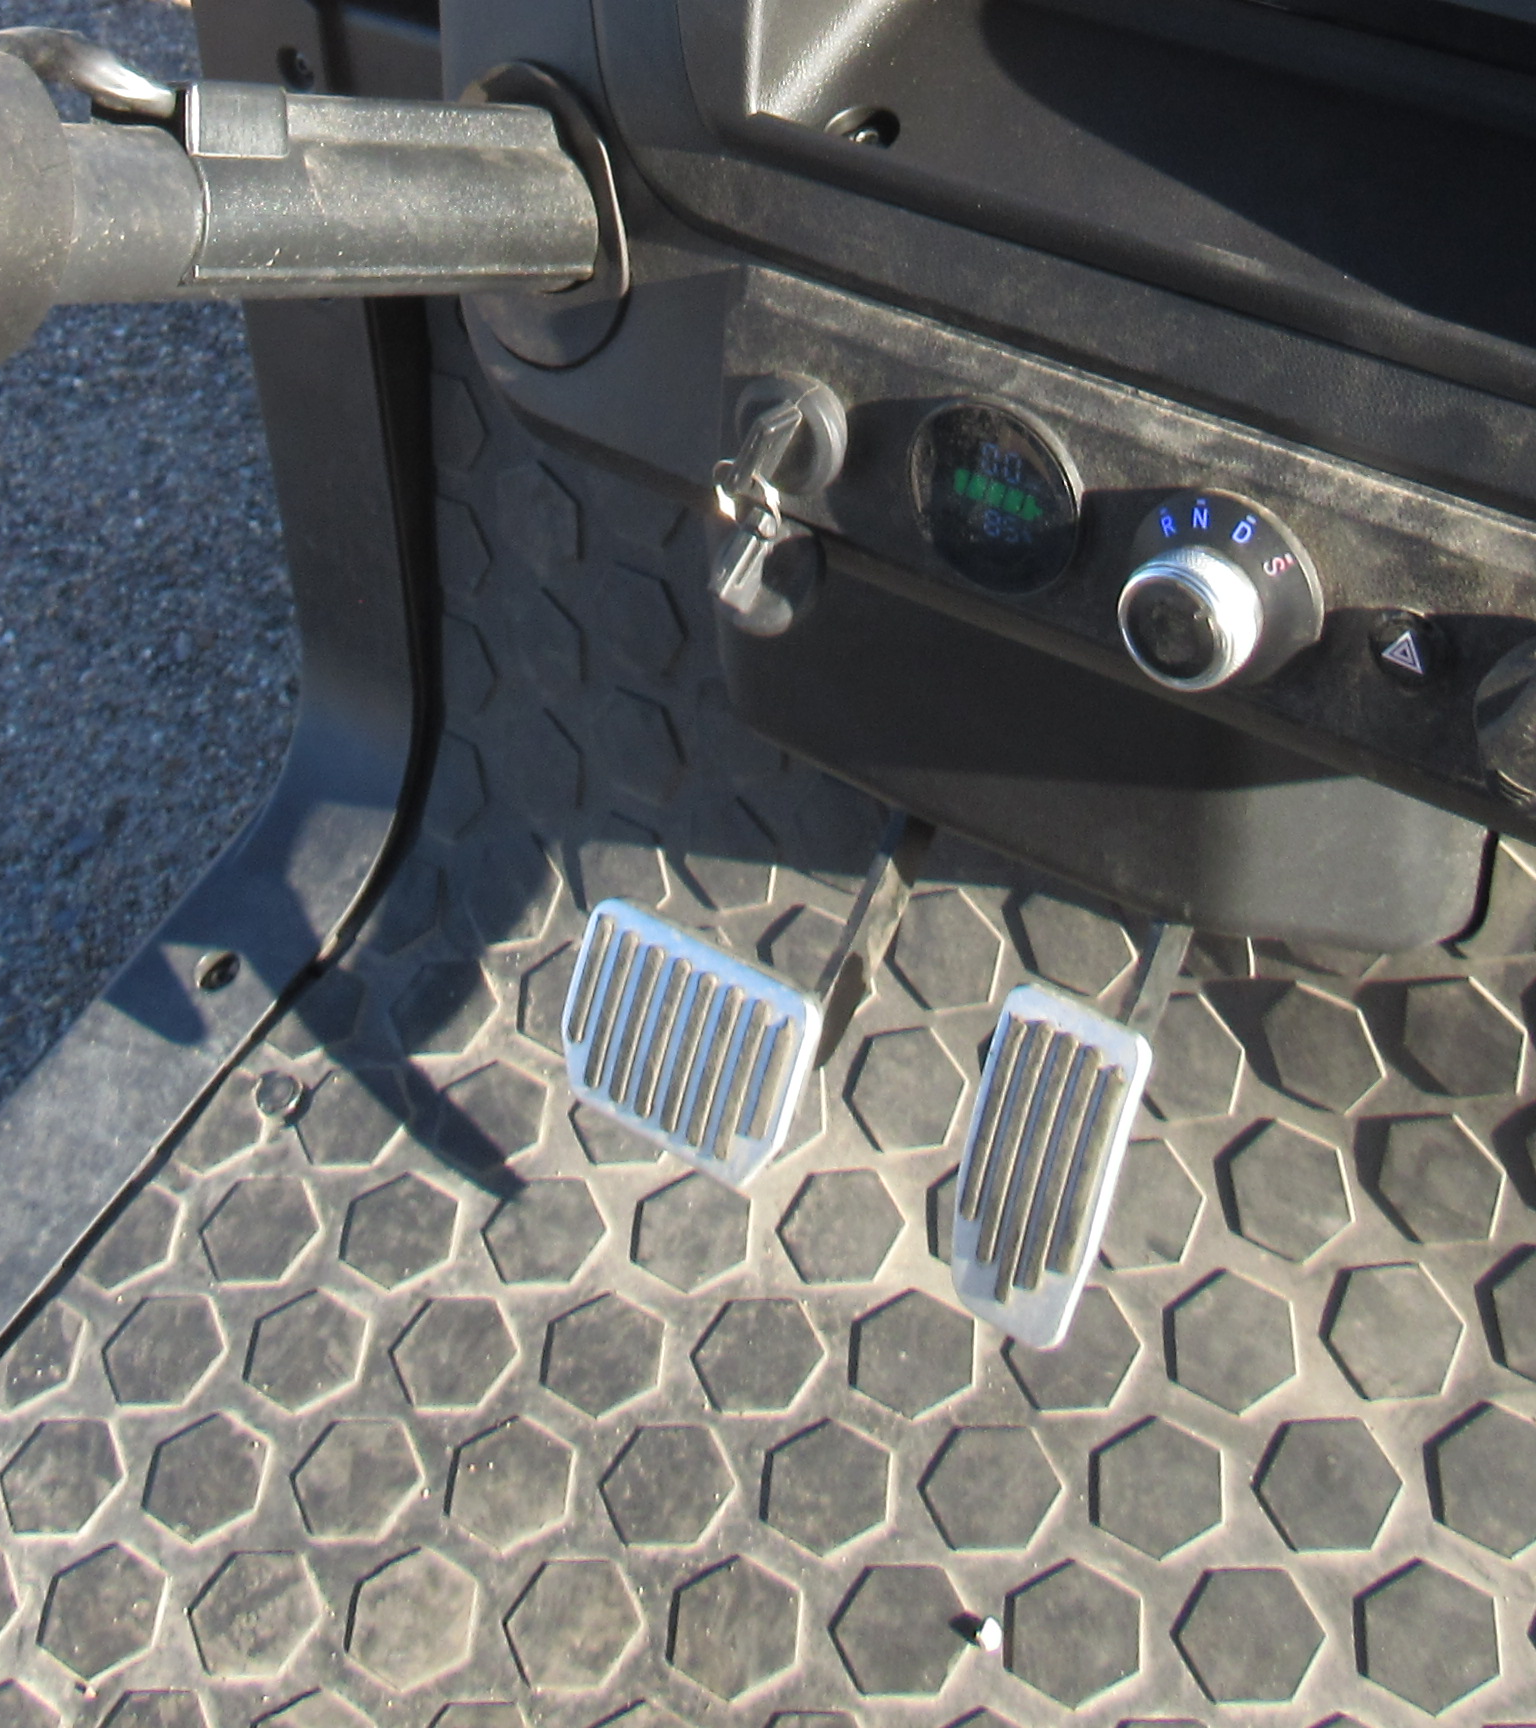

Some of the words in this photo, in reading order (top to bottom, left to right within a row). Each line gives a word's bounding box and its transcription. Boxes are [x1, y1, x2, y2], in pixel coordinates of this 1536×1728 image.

[1160, 515, 1176, 538] R
[1191, 506, 1210, 531] N
[1231, 519, 1254, 545] D
[1262, 555, 1287, 577] S
